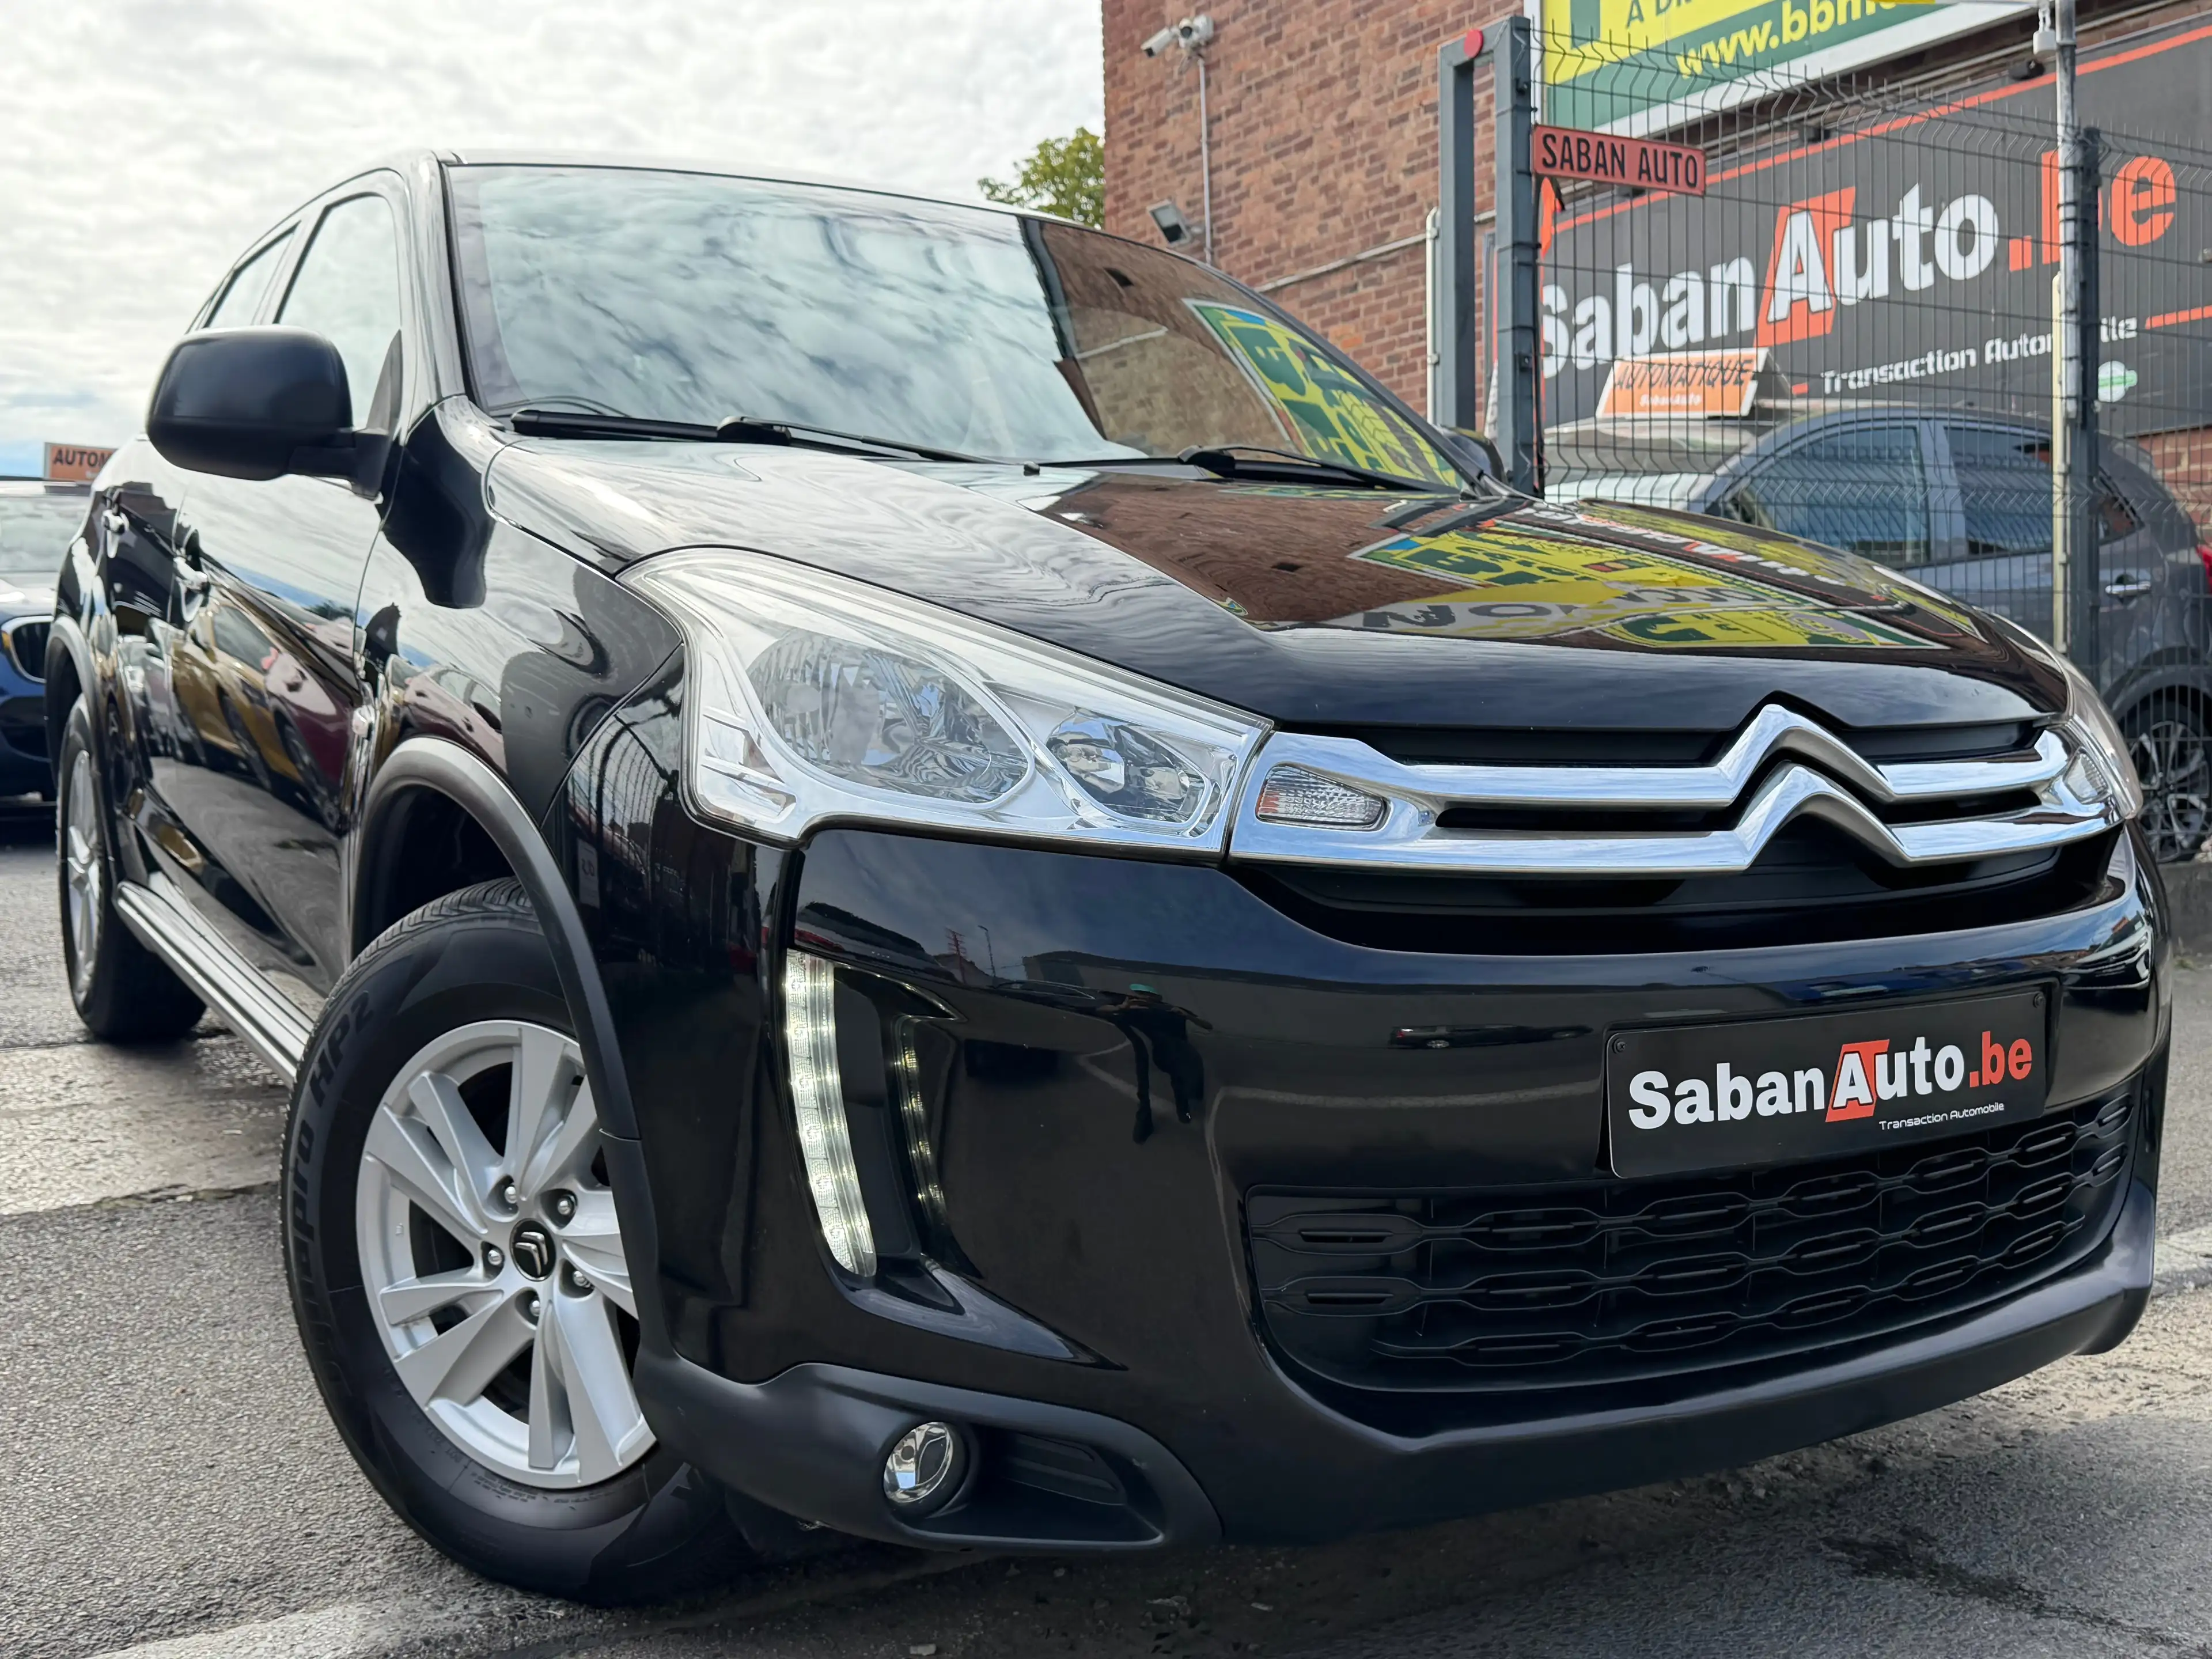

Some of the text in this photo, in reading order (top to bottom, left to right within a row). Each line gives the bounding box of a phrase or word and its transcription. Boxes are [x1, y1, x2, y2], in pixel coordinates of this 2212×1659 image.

[1675, 0, 1896, 79] www.bbm
[1542, 133, 1698, 188] SABAN AUTO
[1615, 358, 1755, 391] AUTOMATIQUE
[1820, 316, 2138, 395] Transaction Autoile
[309, 990, 373, 1108] HP2
[1628, 1031, 2032, 1130] SabanAuto.be
[1878, 1102, 2005, 1130] Transaction Automobile
